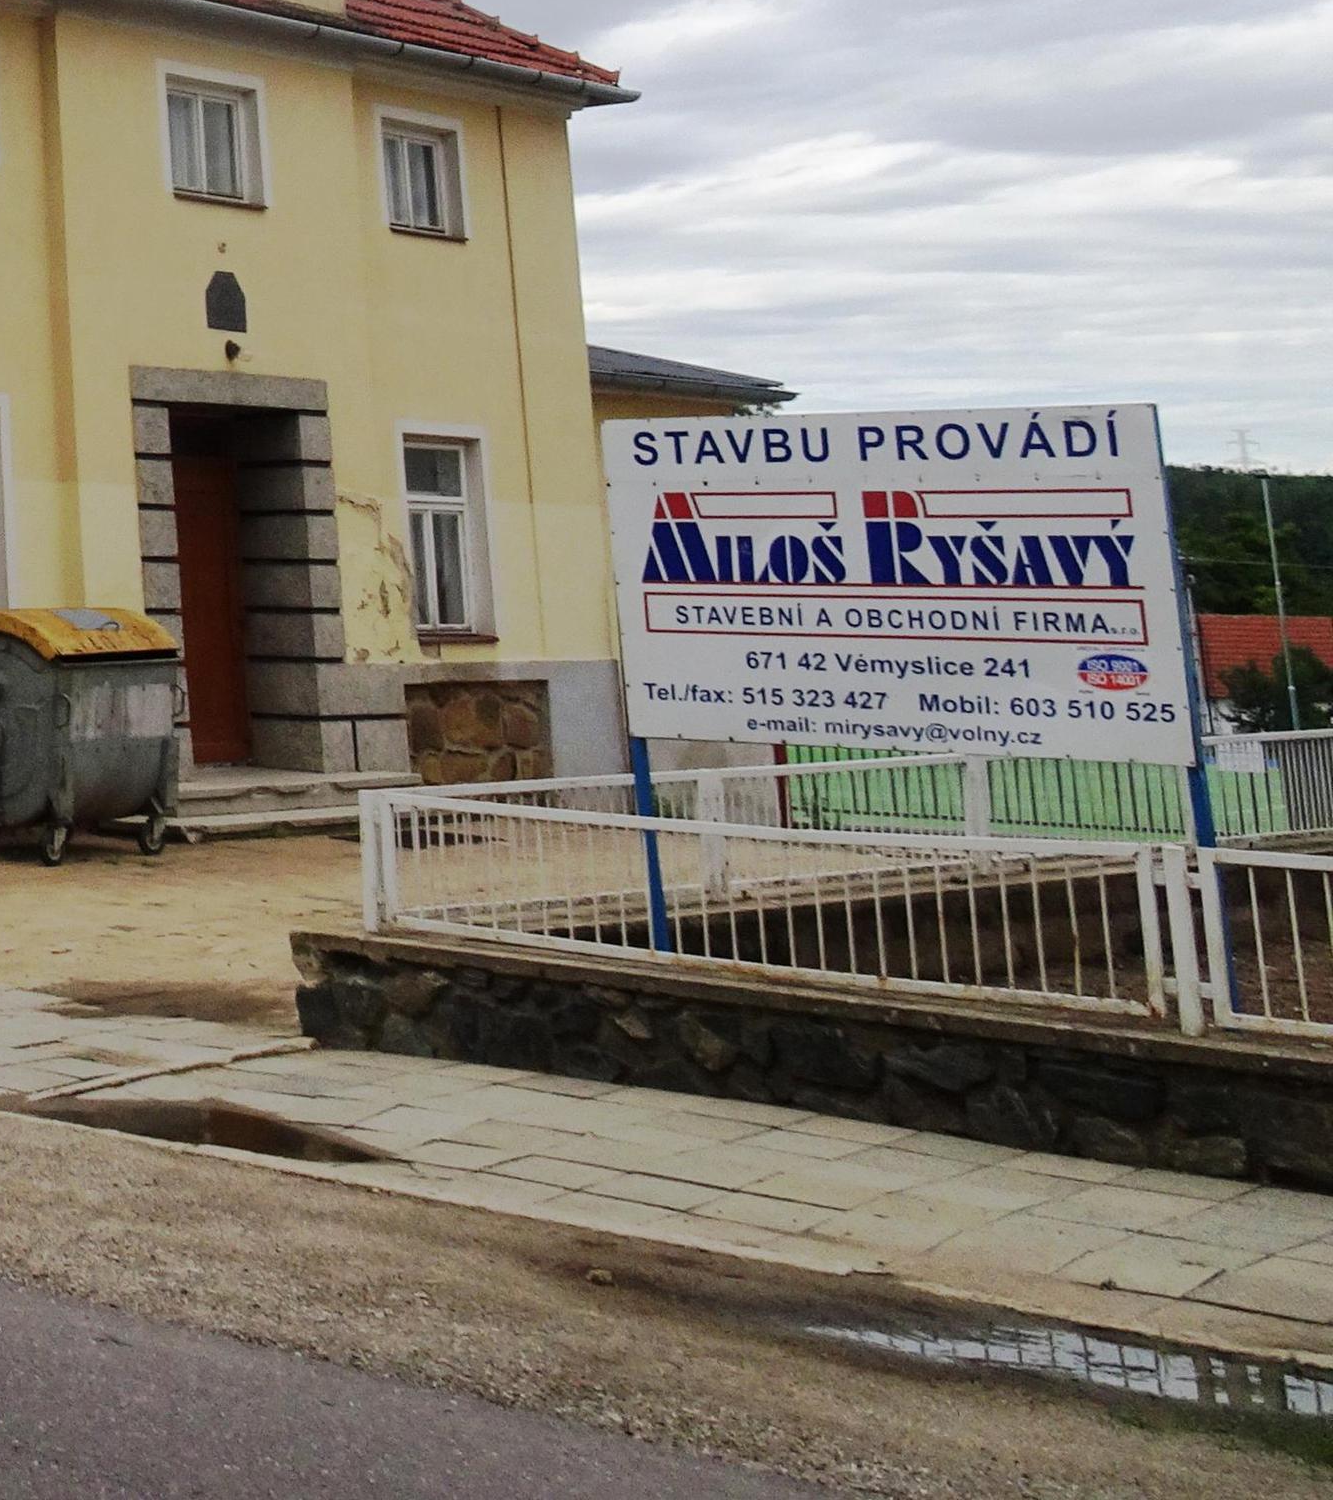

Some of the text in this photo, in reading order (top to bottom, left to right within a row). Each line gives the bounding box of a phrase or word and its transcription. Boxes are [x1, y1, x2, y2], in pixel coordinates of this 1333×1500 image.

[633, 410, 1119, 466] STAVBU PROVÁDÍ
[676, 603, 803, 626] STAVEBNÍ
[816, 607, 833, 628] A
[845, 606, 1000, 632] OBCHODNÍ
[1014, 611, 1110, 635] FIRMA
[746, 651, 787, 670] 671
[797, 653, 827, 672] 42
[983, 657, 1031, 678] 241
[644, 682, 1175, 723] Tel./fax: 515 323 427 Mobil: 603 510 525
[747, 716, 1042, 746] e-mail: mirysavy@volny.cz
